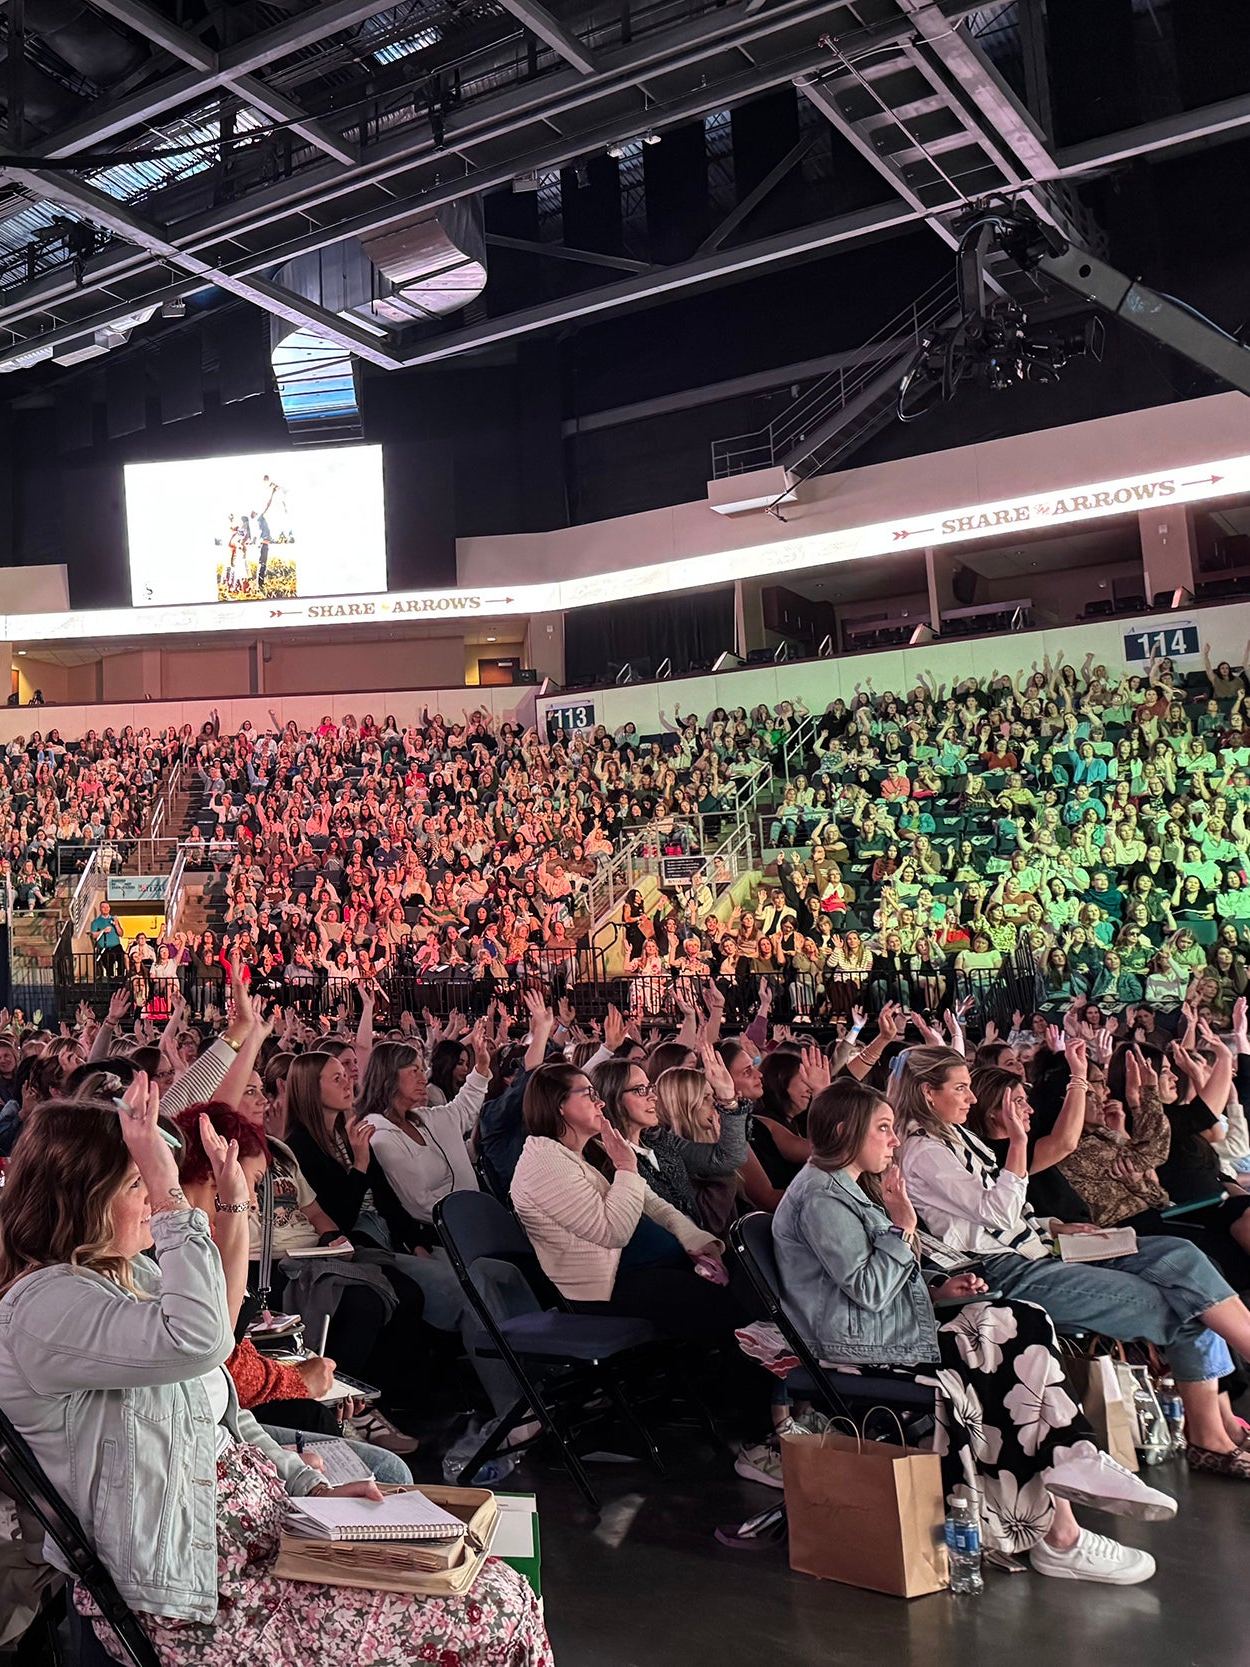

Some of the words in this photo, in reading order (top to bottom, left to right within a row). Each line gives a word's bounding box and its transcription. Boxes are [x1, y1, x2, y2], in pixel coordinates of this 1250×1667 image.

[941, 505, 1031, 535] SHARE
[1052, 479, 1176, 516] ARROWS
[307, 602, 376, 618] SHARE
[392, 596, 481, 613] ARROWS
[1137, 629, 1187, 658] 114
[554, 707, 587, 728] 113
